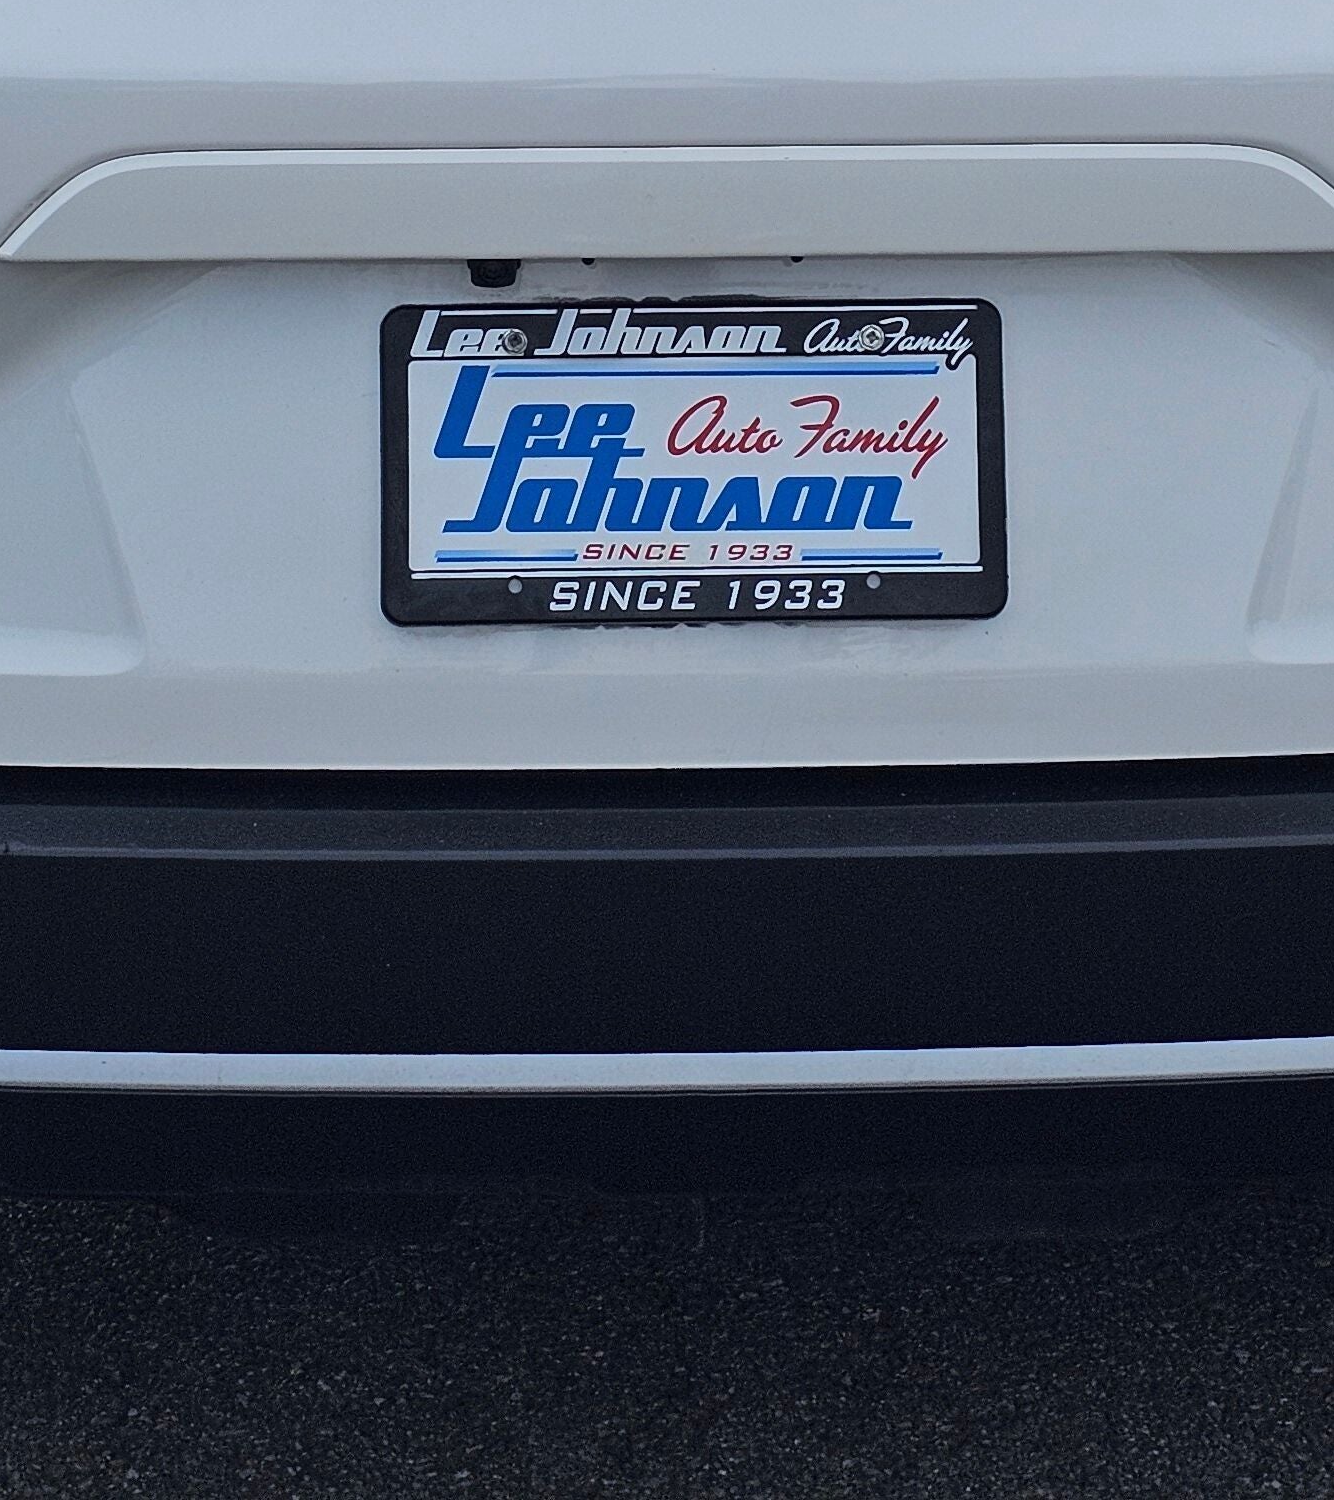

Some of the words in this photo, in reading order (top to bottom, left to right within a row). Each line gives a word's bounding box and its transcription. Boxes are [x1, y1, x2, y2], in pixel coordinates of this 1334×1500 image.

[533, 308, 787, 356] Johnson
[878, 315, 974, 366] Family
[433, 365, 646, 459] Lee
[666, 395, 784, 457] Auto
[789, 394, 948, 480] Family
[441, 445, 914, 534] Johnson
[582, 543, 690, 562] SINCE
[708, 543, 794, 561] 1933
[549, 581, 701, 611] SINCE
[726, 579, 847, 609] 1933
